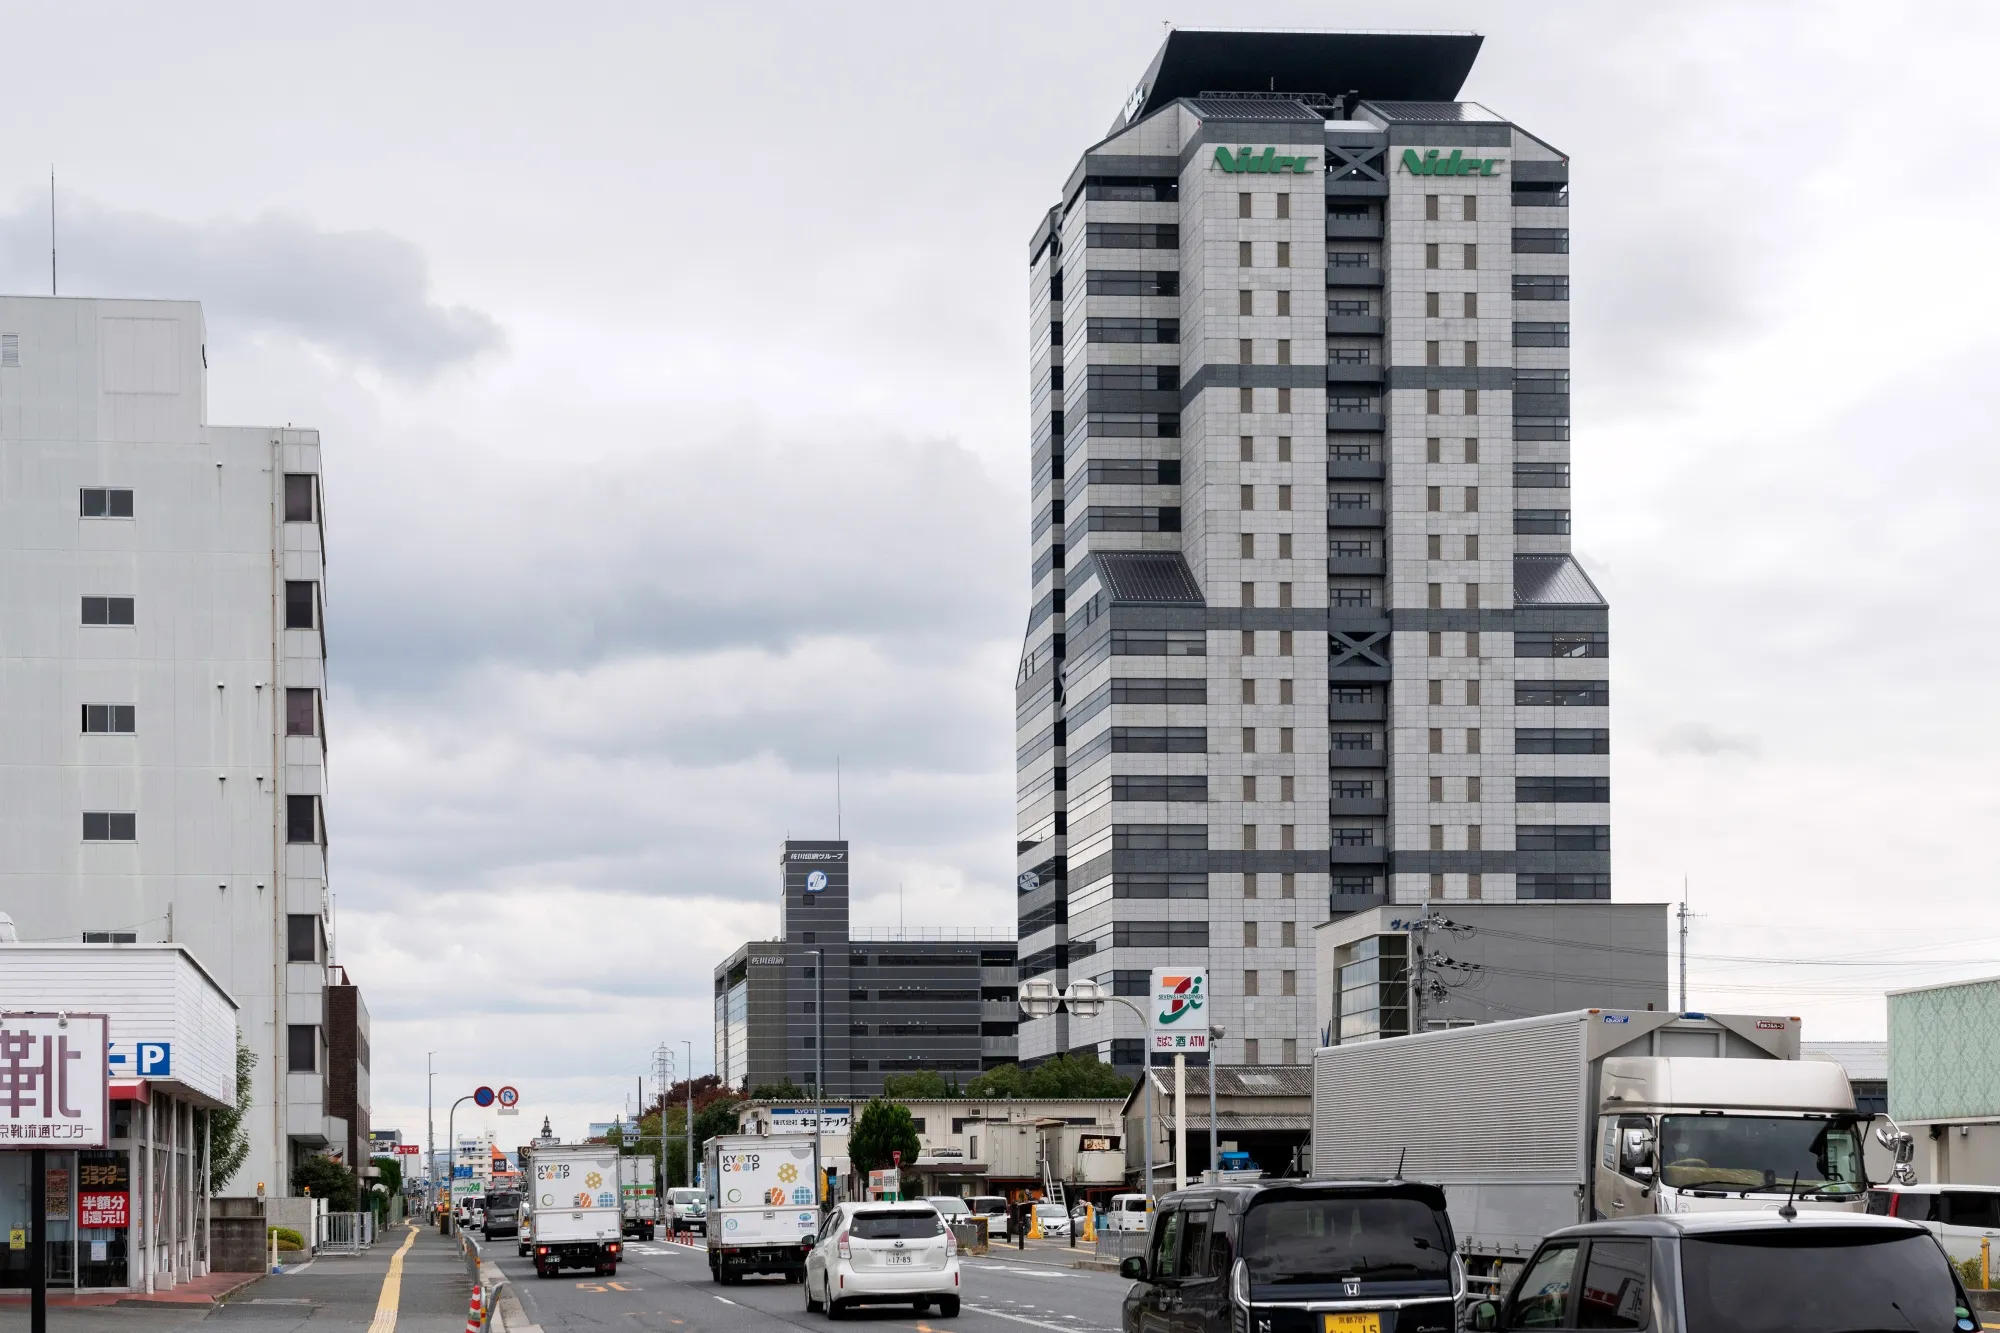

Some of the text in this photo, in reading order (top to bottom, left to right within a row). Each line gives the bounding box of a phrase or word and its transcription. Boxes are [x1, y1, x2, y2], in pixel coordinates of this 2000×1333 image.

[1210, 146, 1318, 174] Nidec
[1398, 148, 1505, 177] Nidec
[751, 956, 785, 965] 佐川印刷
[1156, 1036, 1205, 1047] たばこ 酒 ATM
[142, 1045, 165, 1073] P
[0, 1030, 81, 1118] 靴
[722, 1154, 760, 1163] KYOTO
[537, 1164, 570, 1172] KYOTO
[722, 1163, 760, 1172] COOP
[81, 1175, 127, 1185] フライデー
[537, 1172, 570, 1180] COOP
[82, 1196, 125, 1210] 半額分
